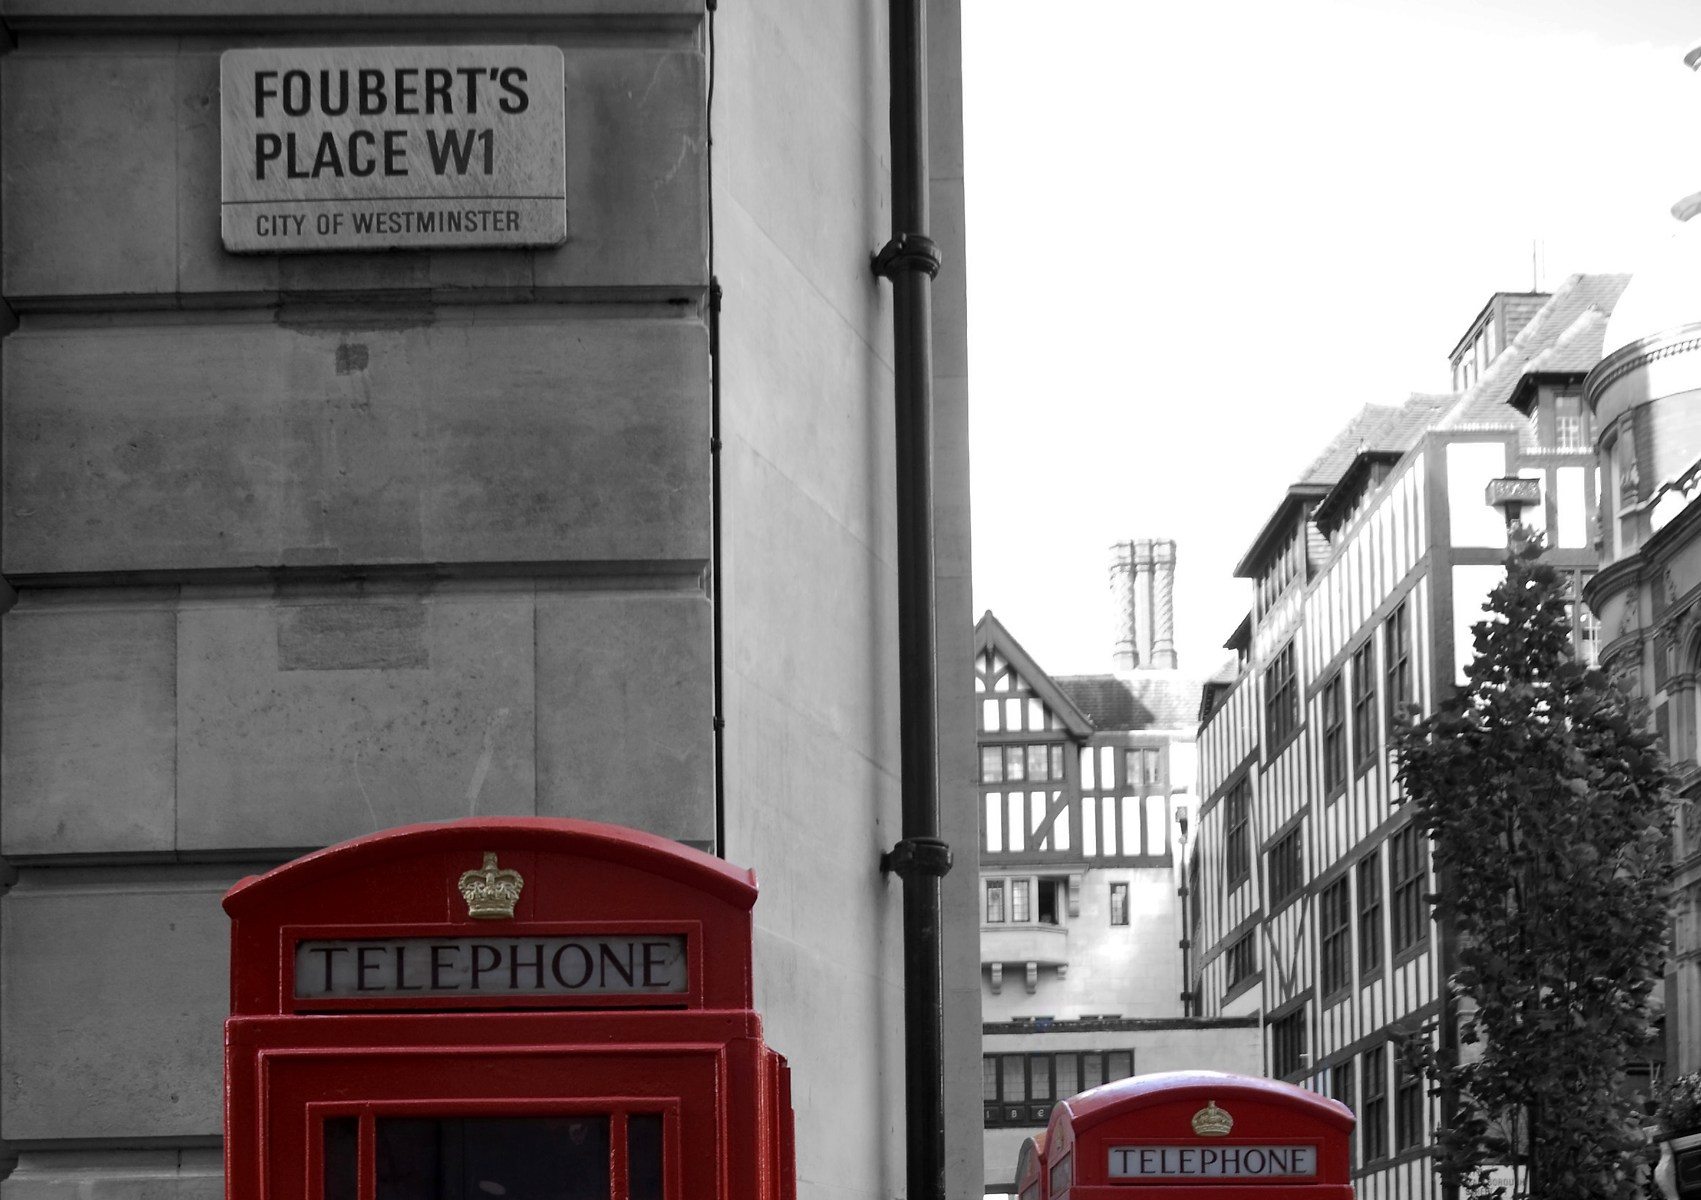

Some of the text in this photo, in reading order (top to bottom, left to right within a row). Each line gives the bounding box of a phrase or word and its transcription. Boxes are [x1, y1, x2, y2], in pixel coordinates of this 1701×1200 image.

[254, 66, 530, 118] FOUBERT'S
[255, 128, 494, 180] PLACE W1
[256, 210, 520, 237] CITY OF WESTMINSTER
[308, 941, 671, 993] TELEPHONE
[1113, 1148, 1308, 1175] TELEPHONE
